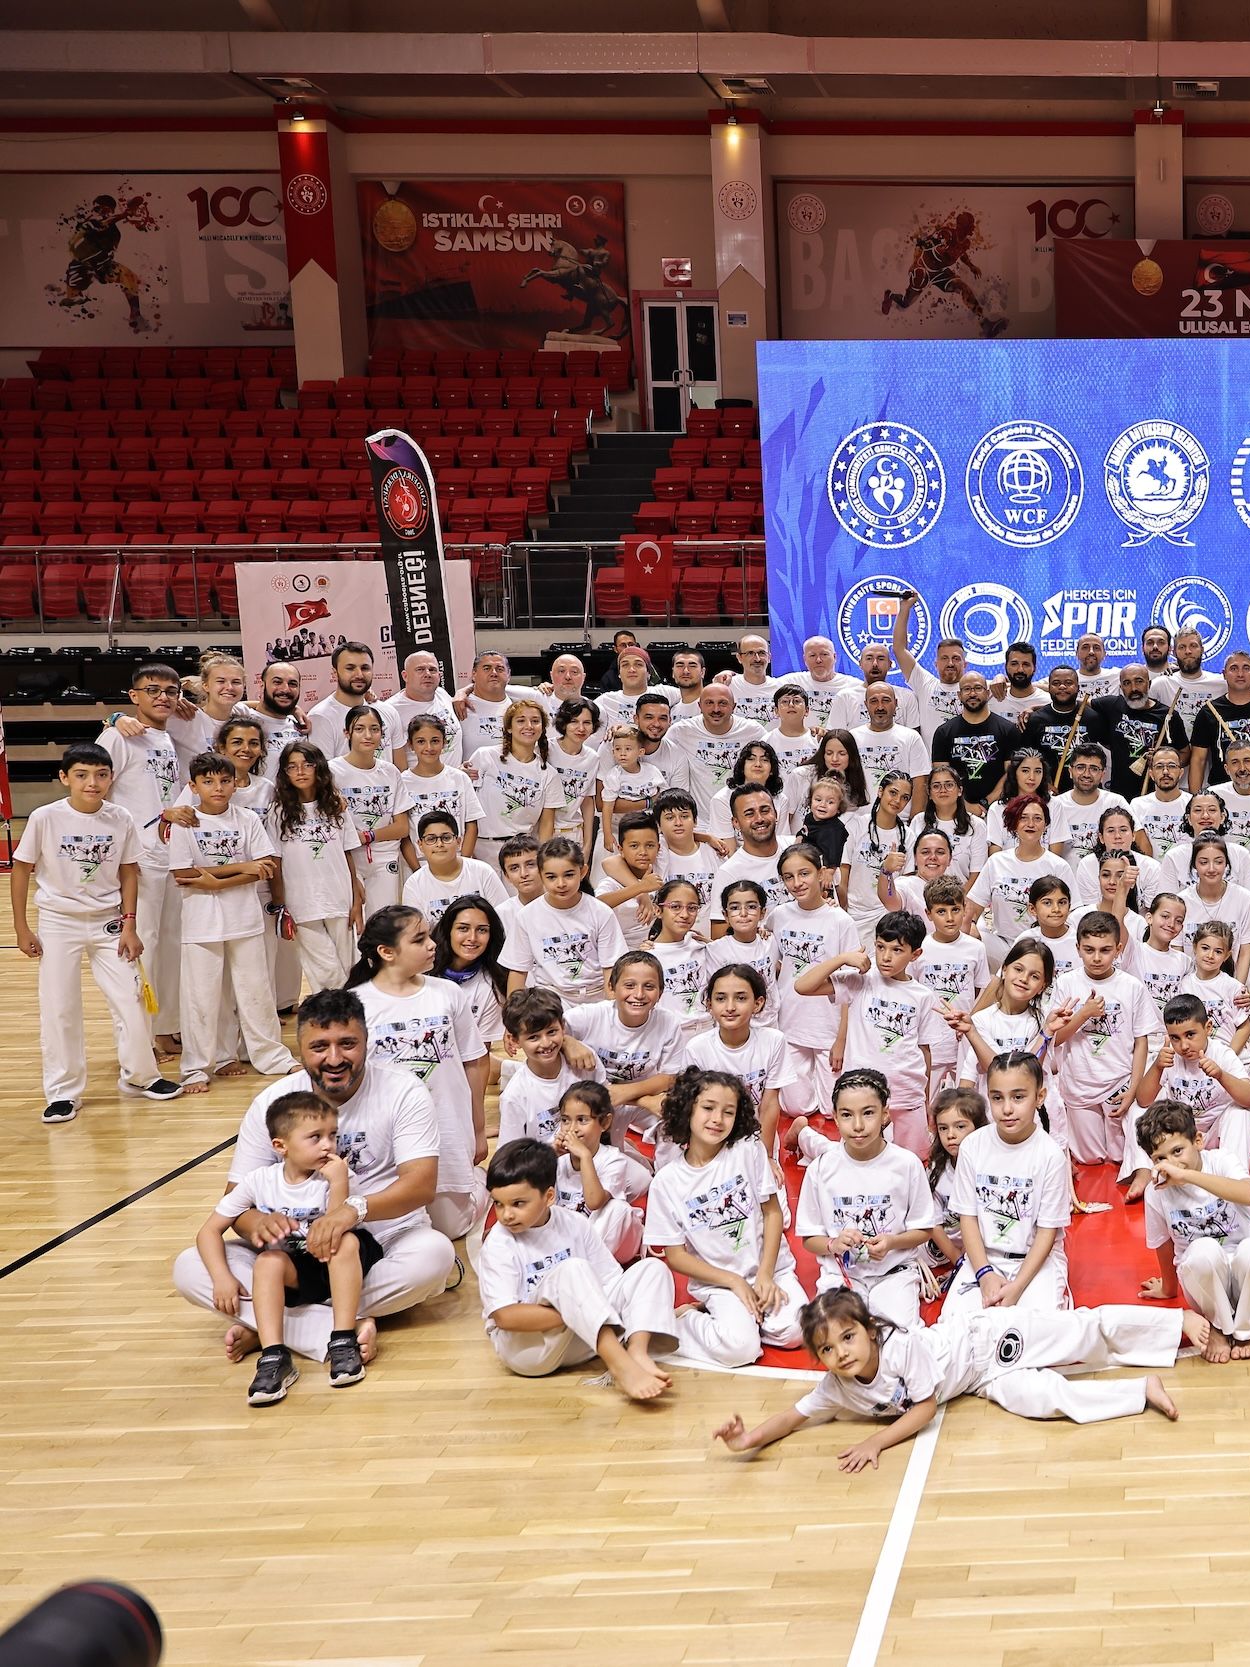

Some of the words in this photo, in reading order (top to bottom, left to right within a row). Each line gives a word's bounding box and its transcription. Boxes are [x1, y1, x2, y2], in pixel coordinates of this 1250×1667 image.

[422, 212, 504, 229] İSTİKLAL
[507, 212, 562, 231] ŞEHRİ
[434, 231, 554, 252] SAMSUN
[1179, 288, 1224, 318] 23
[1179, 320, 1236, 334] ULUSAL
[972, 442, 991, 470] World
[990, 425, 1033, 443] Capoeira
[912, 463, 924, 488] SPOR
[1004, 509, 1047, 524] WCF
[1064, 590, 1110, 600] HERKES
[1041, 639, 1138, 651] FEDEYONU
